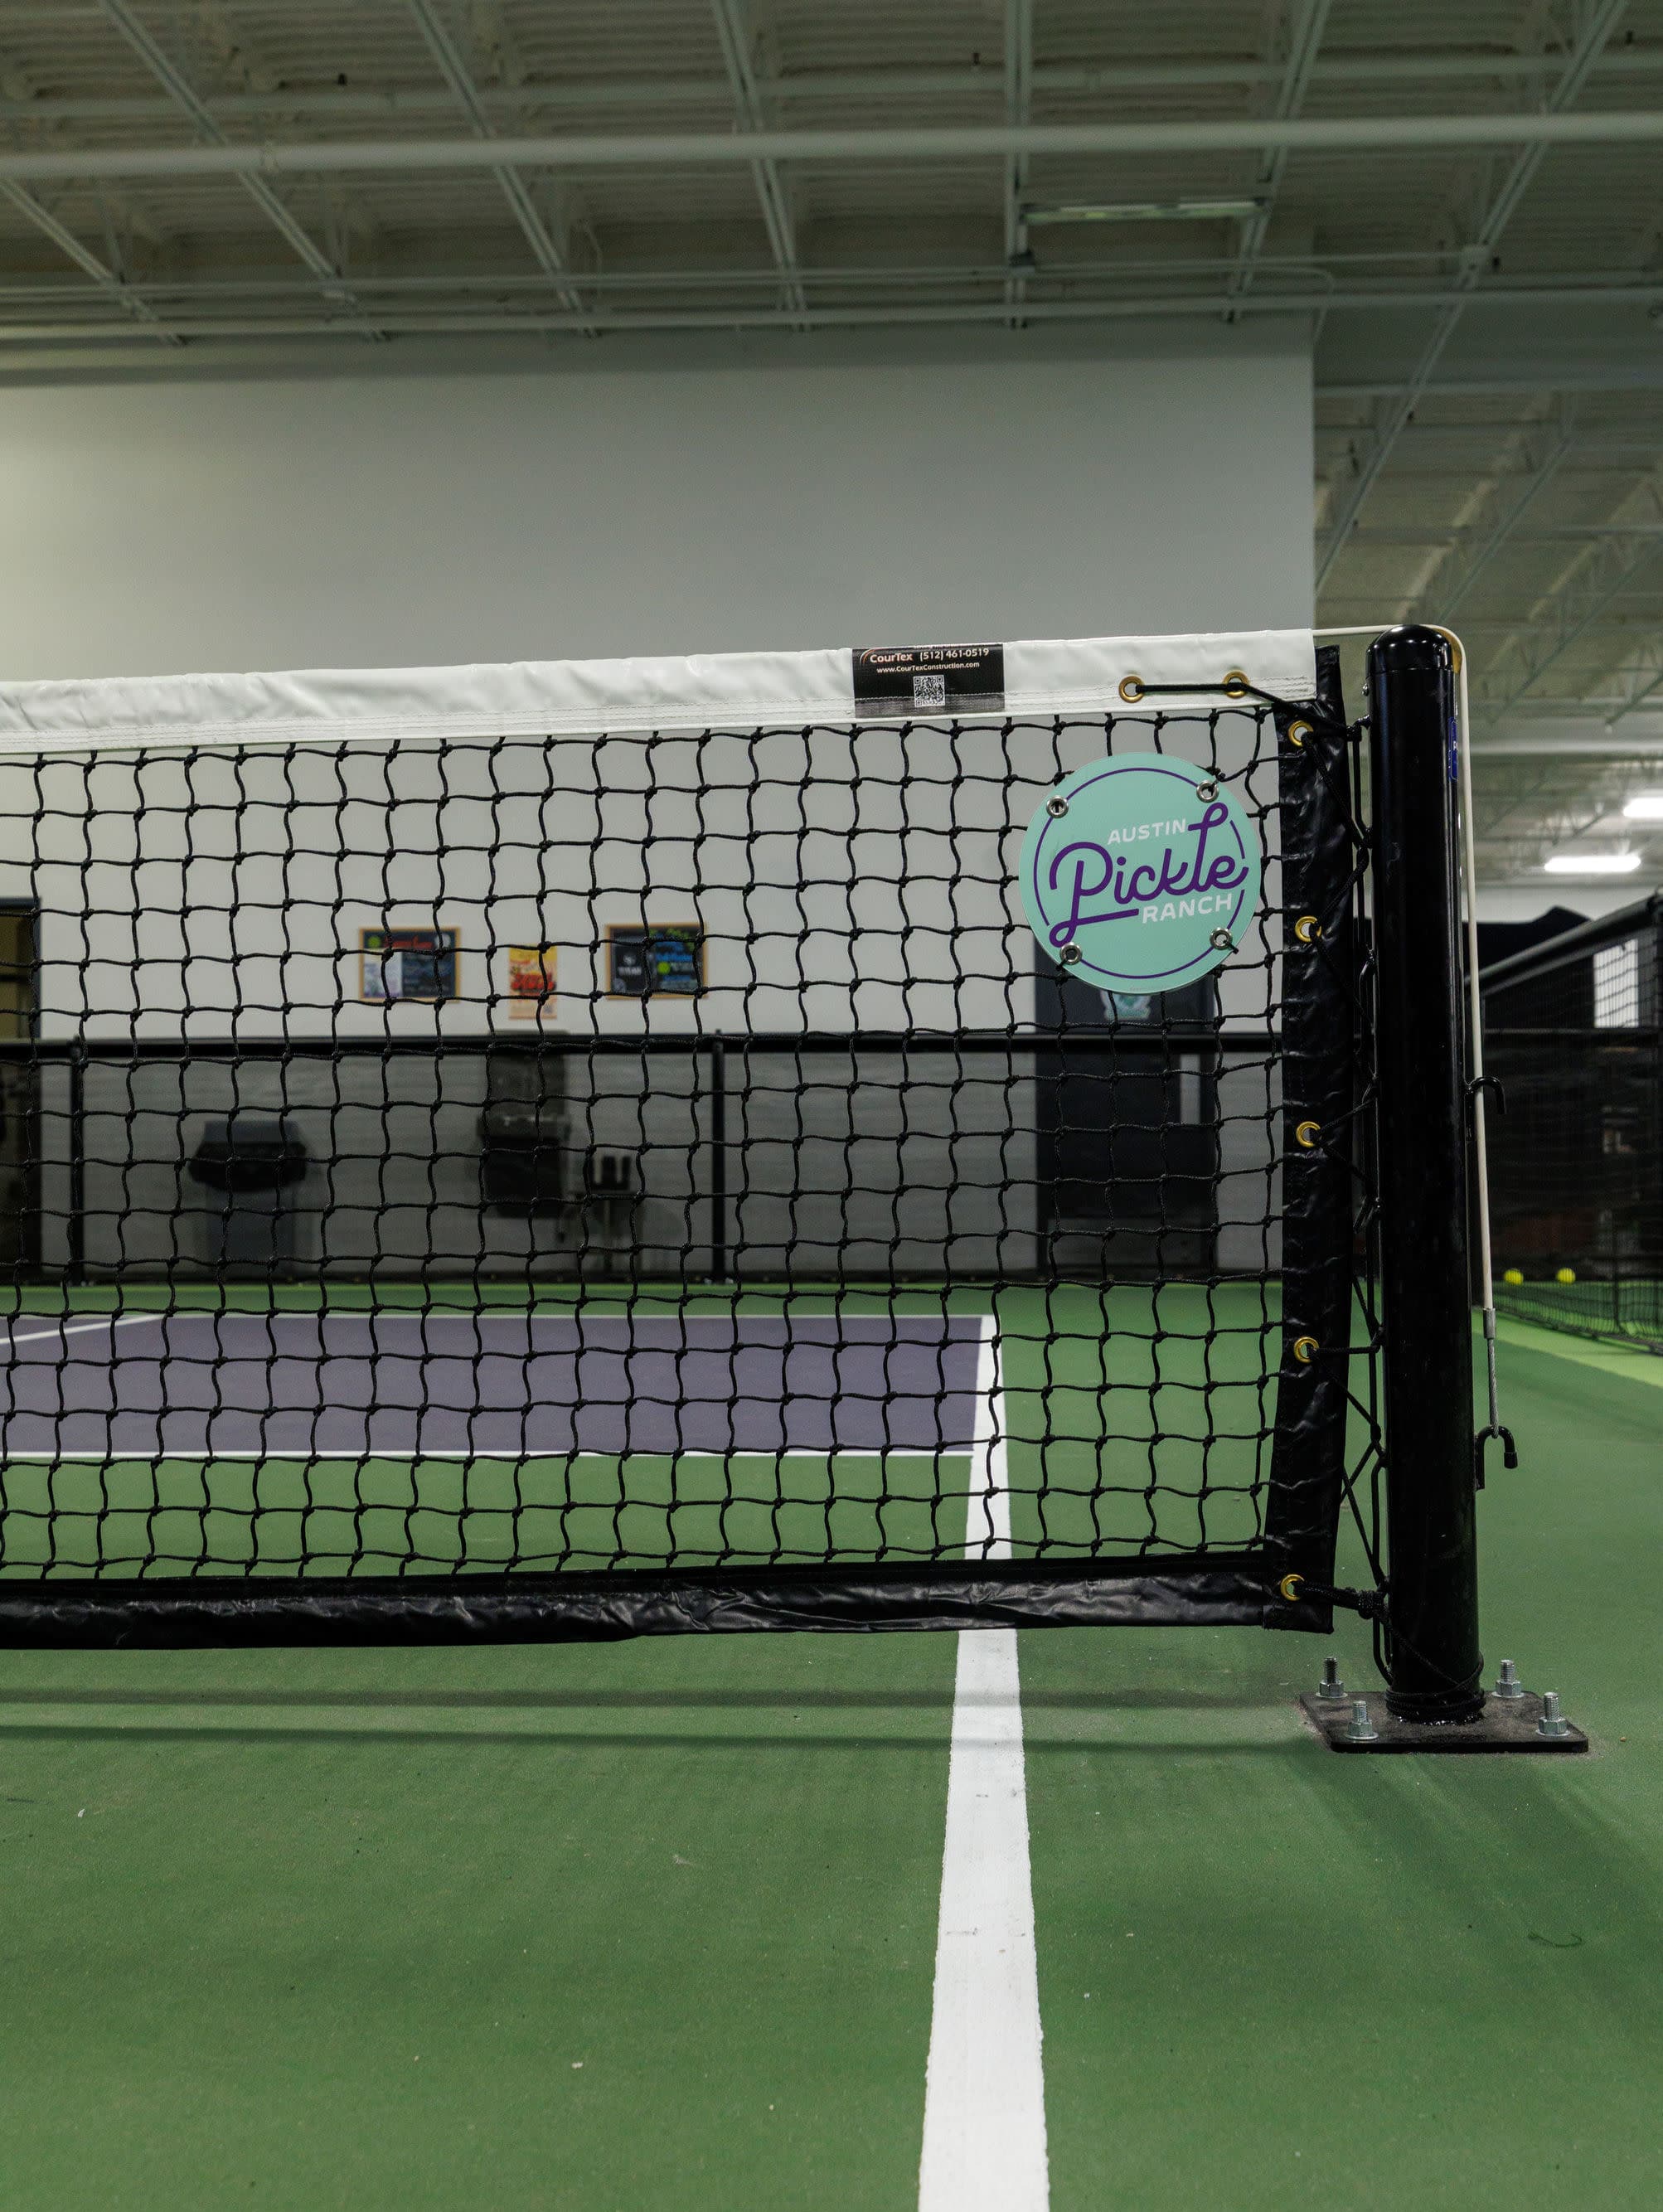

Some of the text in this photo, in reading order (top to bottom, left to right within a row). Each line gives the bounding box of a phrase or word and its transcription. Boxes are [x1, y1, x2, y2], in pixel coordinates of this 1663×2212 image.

[870, 652, 914, 663] CourTex
[919, 651, 943, 662] (512)
[945, 648, 989, 658] 461-0519
[876, 661, 980, 673] www.CourTexConstruction.com
[1107, 817, 1186, 846] AUSTIN
[1049, 802, 1249, 948] Pickle
[1142, 893, 1233, 924] RANCH
